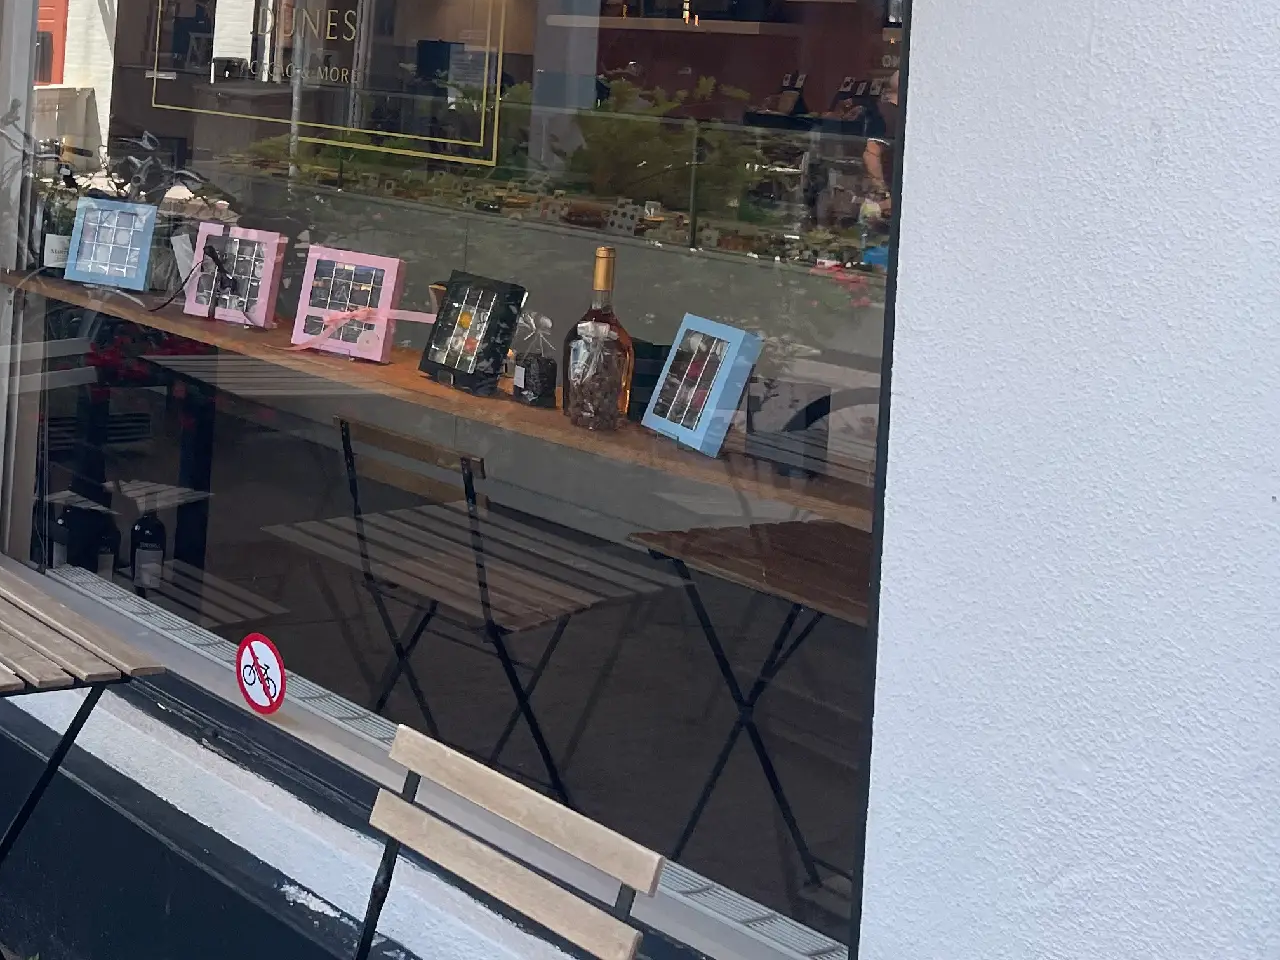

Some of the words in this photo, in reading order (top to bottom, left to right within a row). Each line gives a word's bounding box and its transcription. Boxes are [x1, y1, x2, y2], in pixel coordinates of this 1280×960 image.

[257, 6, 357, 41] DUNES
[250, 60, 297, 78] CCAO
[318, 65, 359, 84] MORE
